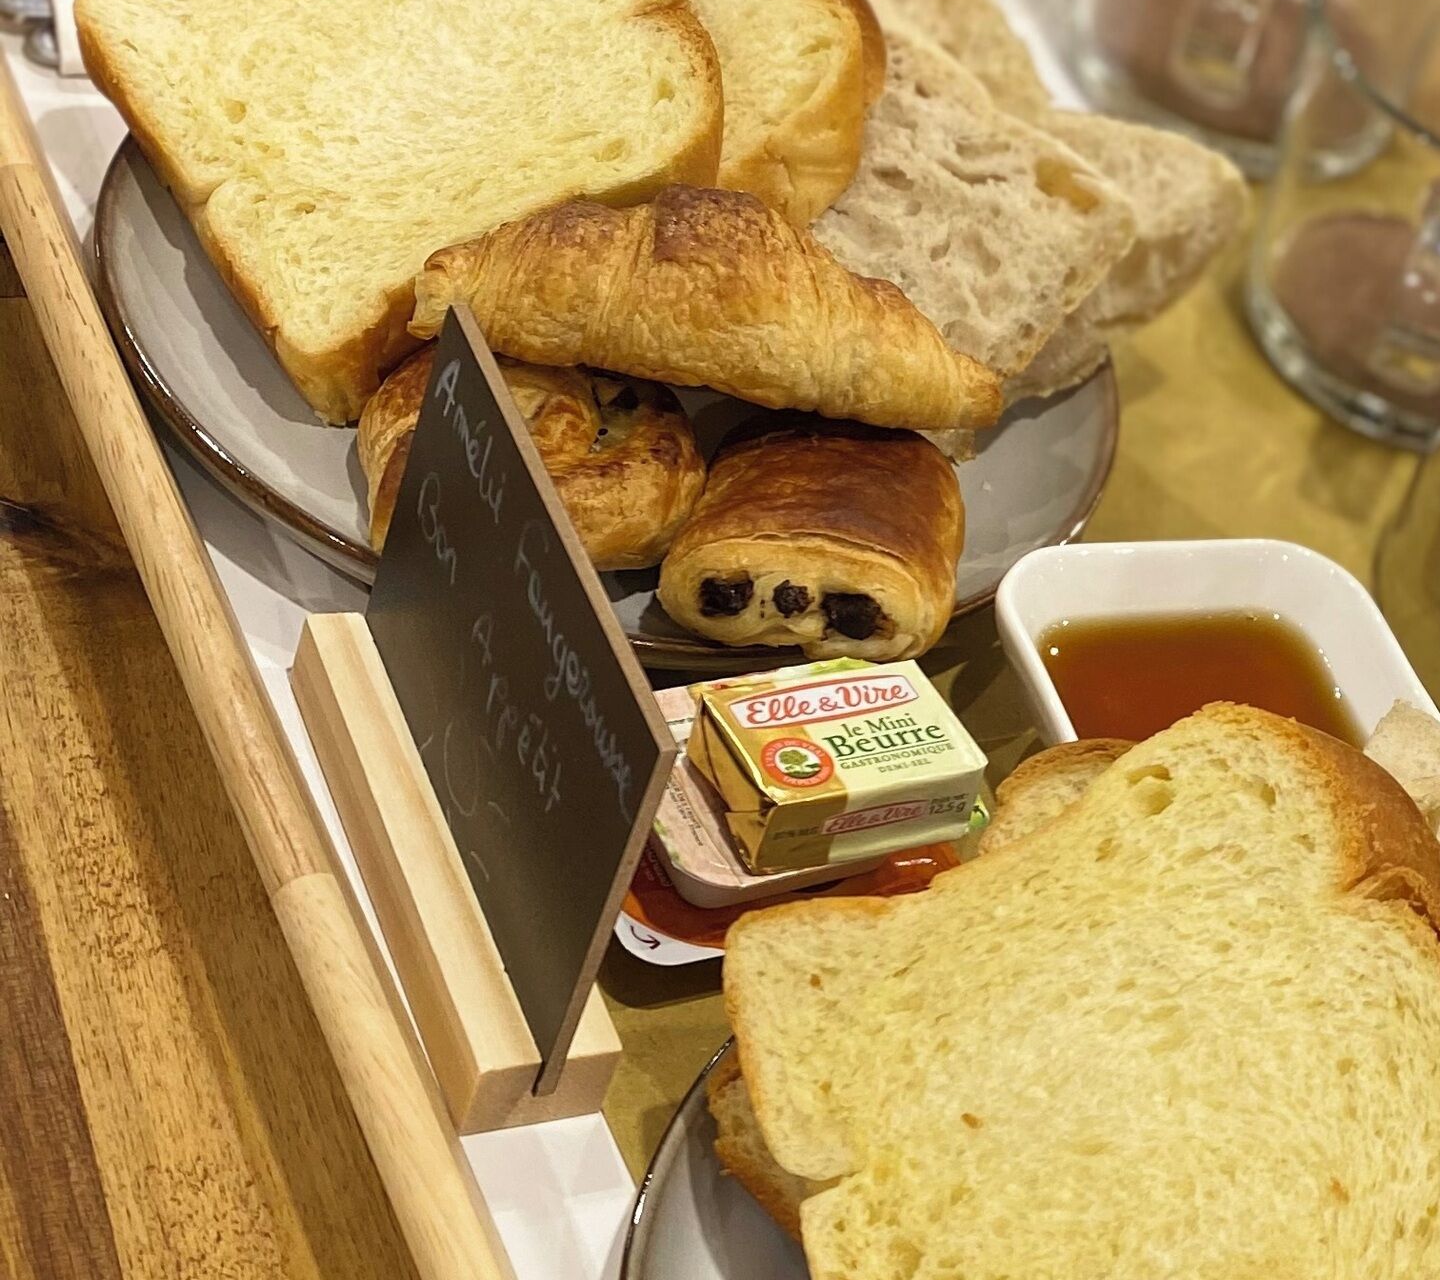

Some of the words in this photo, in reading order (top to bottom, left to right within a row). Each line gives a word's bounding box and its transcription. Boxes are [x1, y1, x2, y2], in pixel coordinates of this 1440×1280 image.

[434, 357, 507, 523] Amélie
[417, 471, 457, 586] Bon
[746, 694, 816, 725] Elle
[818, 697, 839, 712] &
[835, 683, 908, 708] Vire
[822, 724, 945, 758] Beurre
[841, 723, 864, 739] le
[866, 713, 917, 734] Mini
[840, 743, 955, 770] GASTRONOMIQUE
